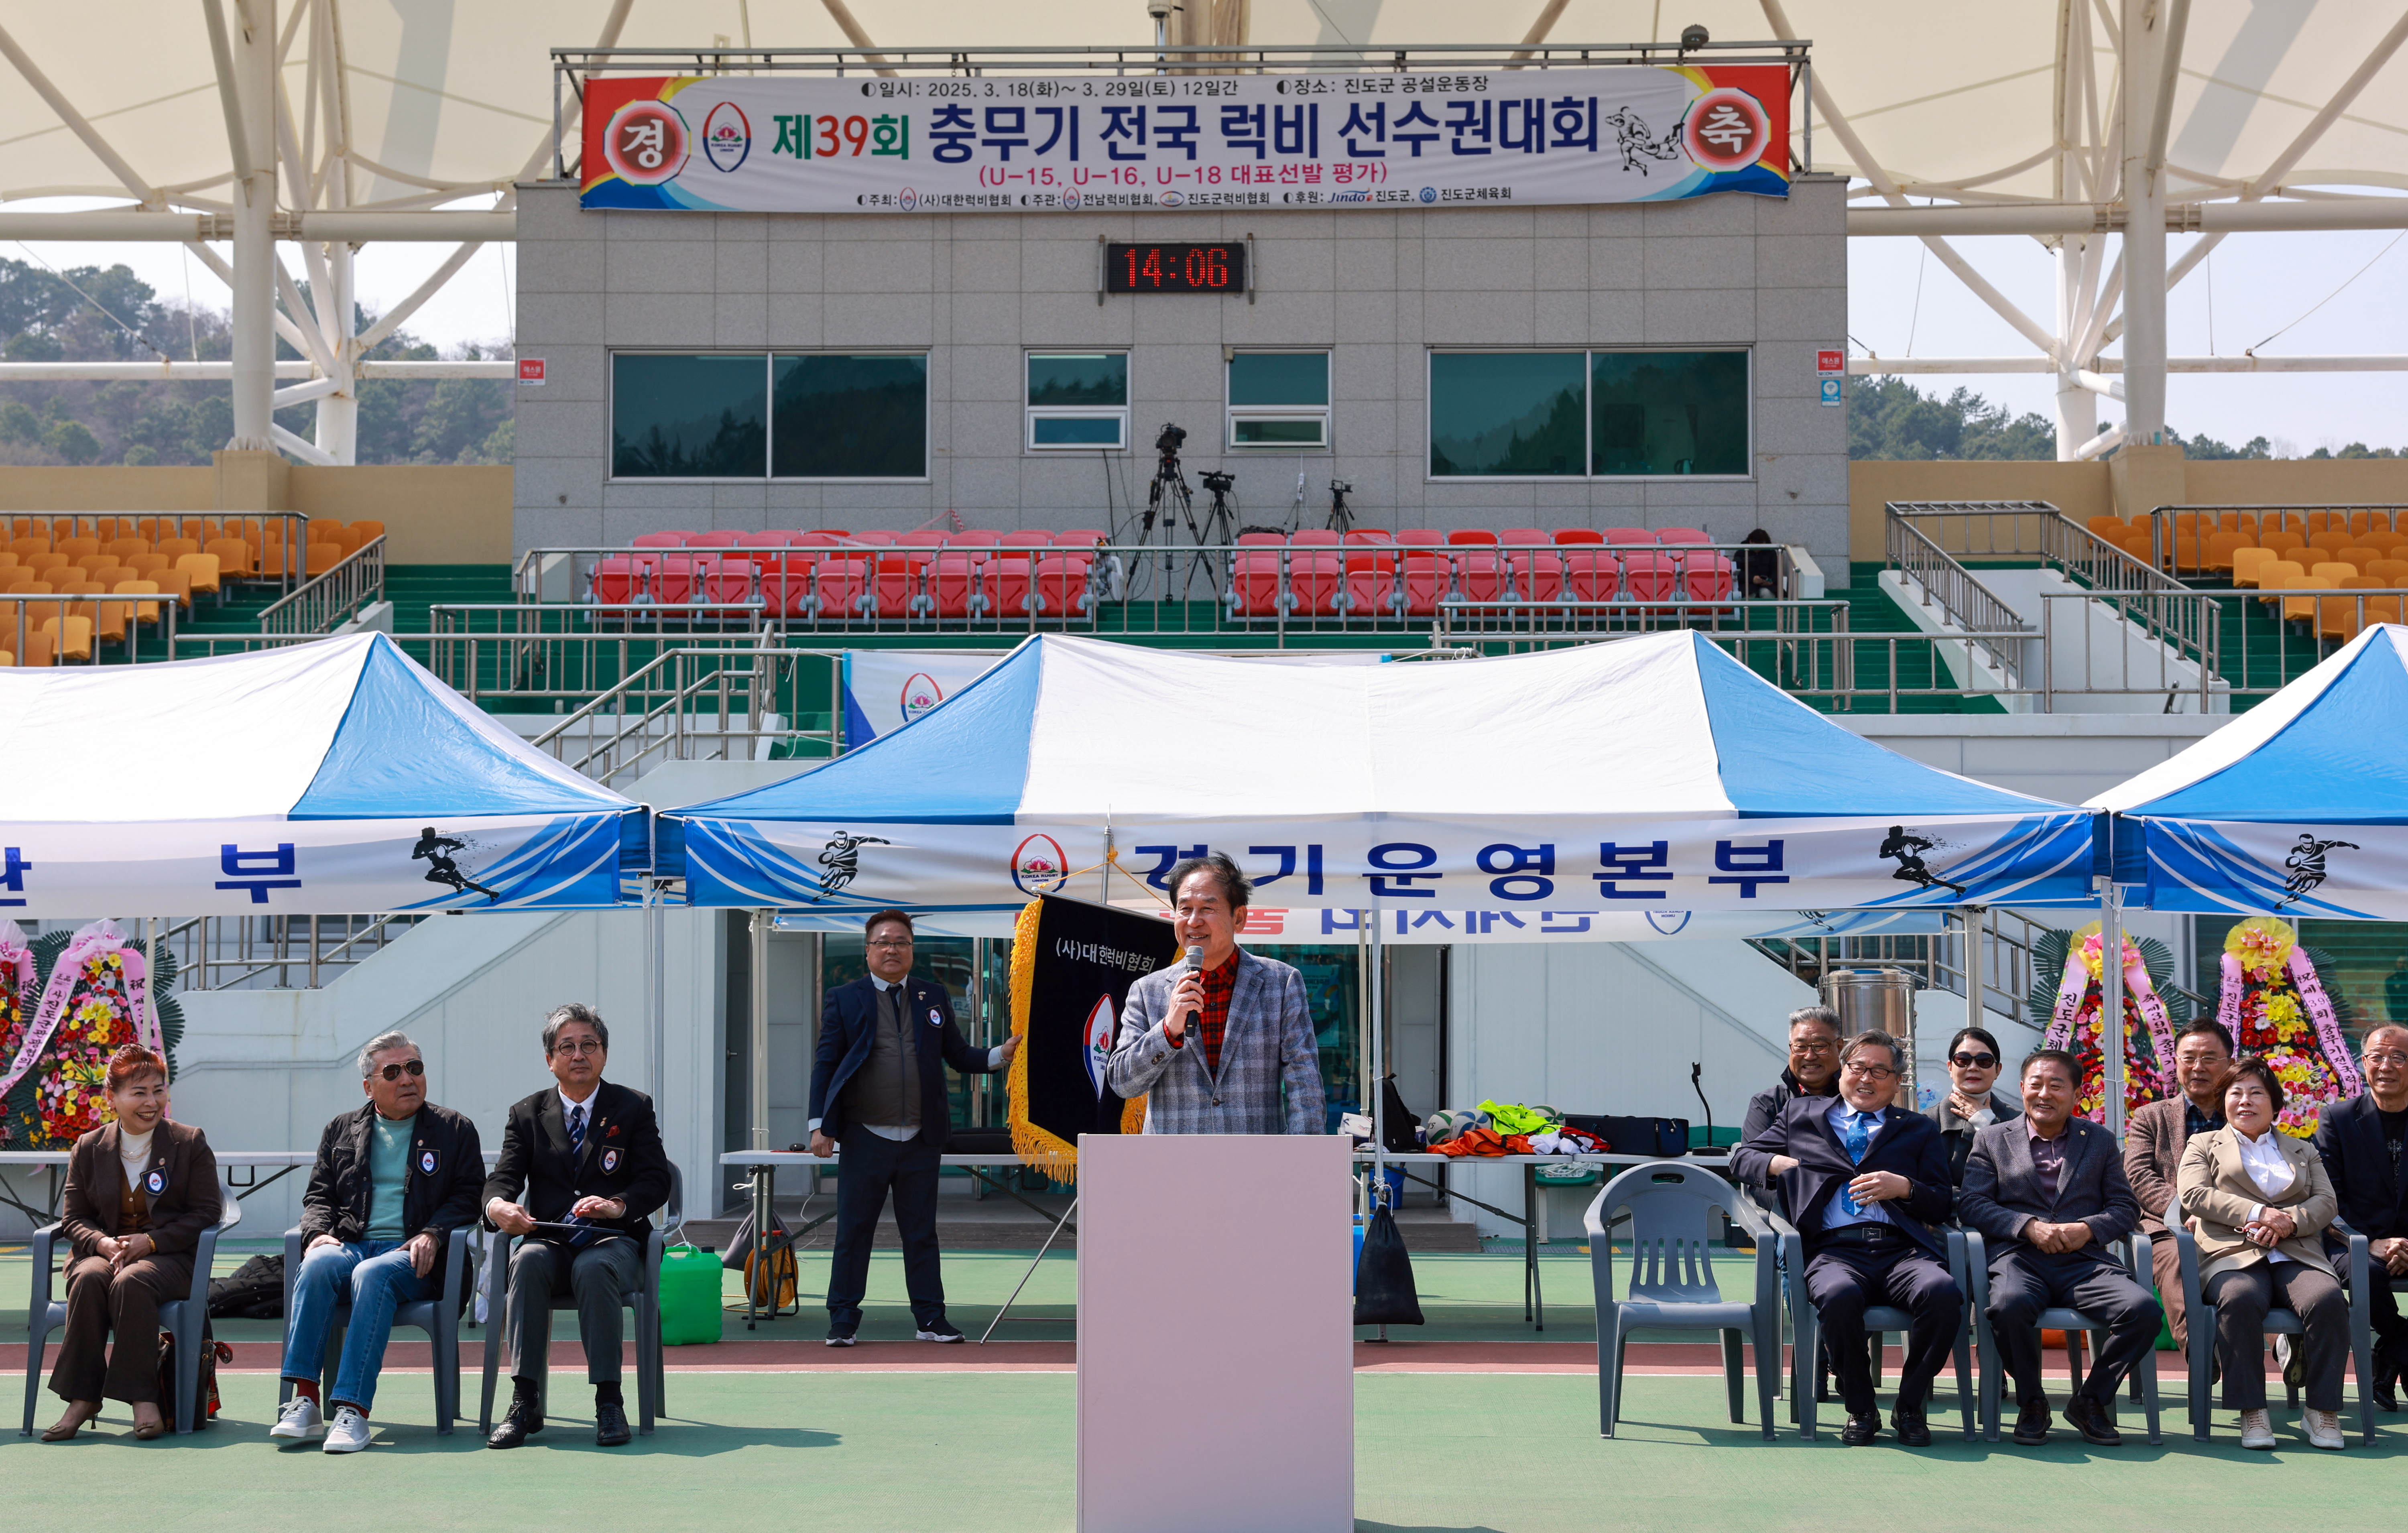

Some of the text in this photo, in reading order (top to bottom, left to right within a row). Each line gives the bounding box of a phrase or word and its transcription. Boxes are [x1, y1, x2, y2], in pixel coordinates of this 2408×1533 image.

[880, 82, 919, 97] 일시:
[929, 83, 976, 97] 2025.
[984, 83, 999, 97] 3.
[1083, 83, 1098, 96] 3.
[1106, 81, 1175, 97] 29일(토)
[1184, 80, 1238, 96] 12일간
[1295, 76, 1488, 95] 장소: 진도군 공설운동장
[772, 96, 1598, 163] 제39회 충무기 전국 럭비 선수권대회
[1699, 106, 1751, 154] 축
[621, 118, 664, 169] 경
[1156, 165, 1222, 185] U-18
[1231, 163, 1324, 185] 대표선발
[1332, 161, 1387, 184] 평가)
[870, 195, 1011, 206] 주최: (사)대한럭비협회
[1033, 193, 1269, 206] 주관: 전남럭비협회, 진도군럭비협회
[1296, 192, 1323, 203] 후원:
[1377, 190, 1414, 202] 진도군,
[1442, 187, 1510, 200] 진도군체육회
[1125, 248, 1228, 287] 14:06
[1056, 937, 1156, 974] (사)대한럭비협회
